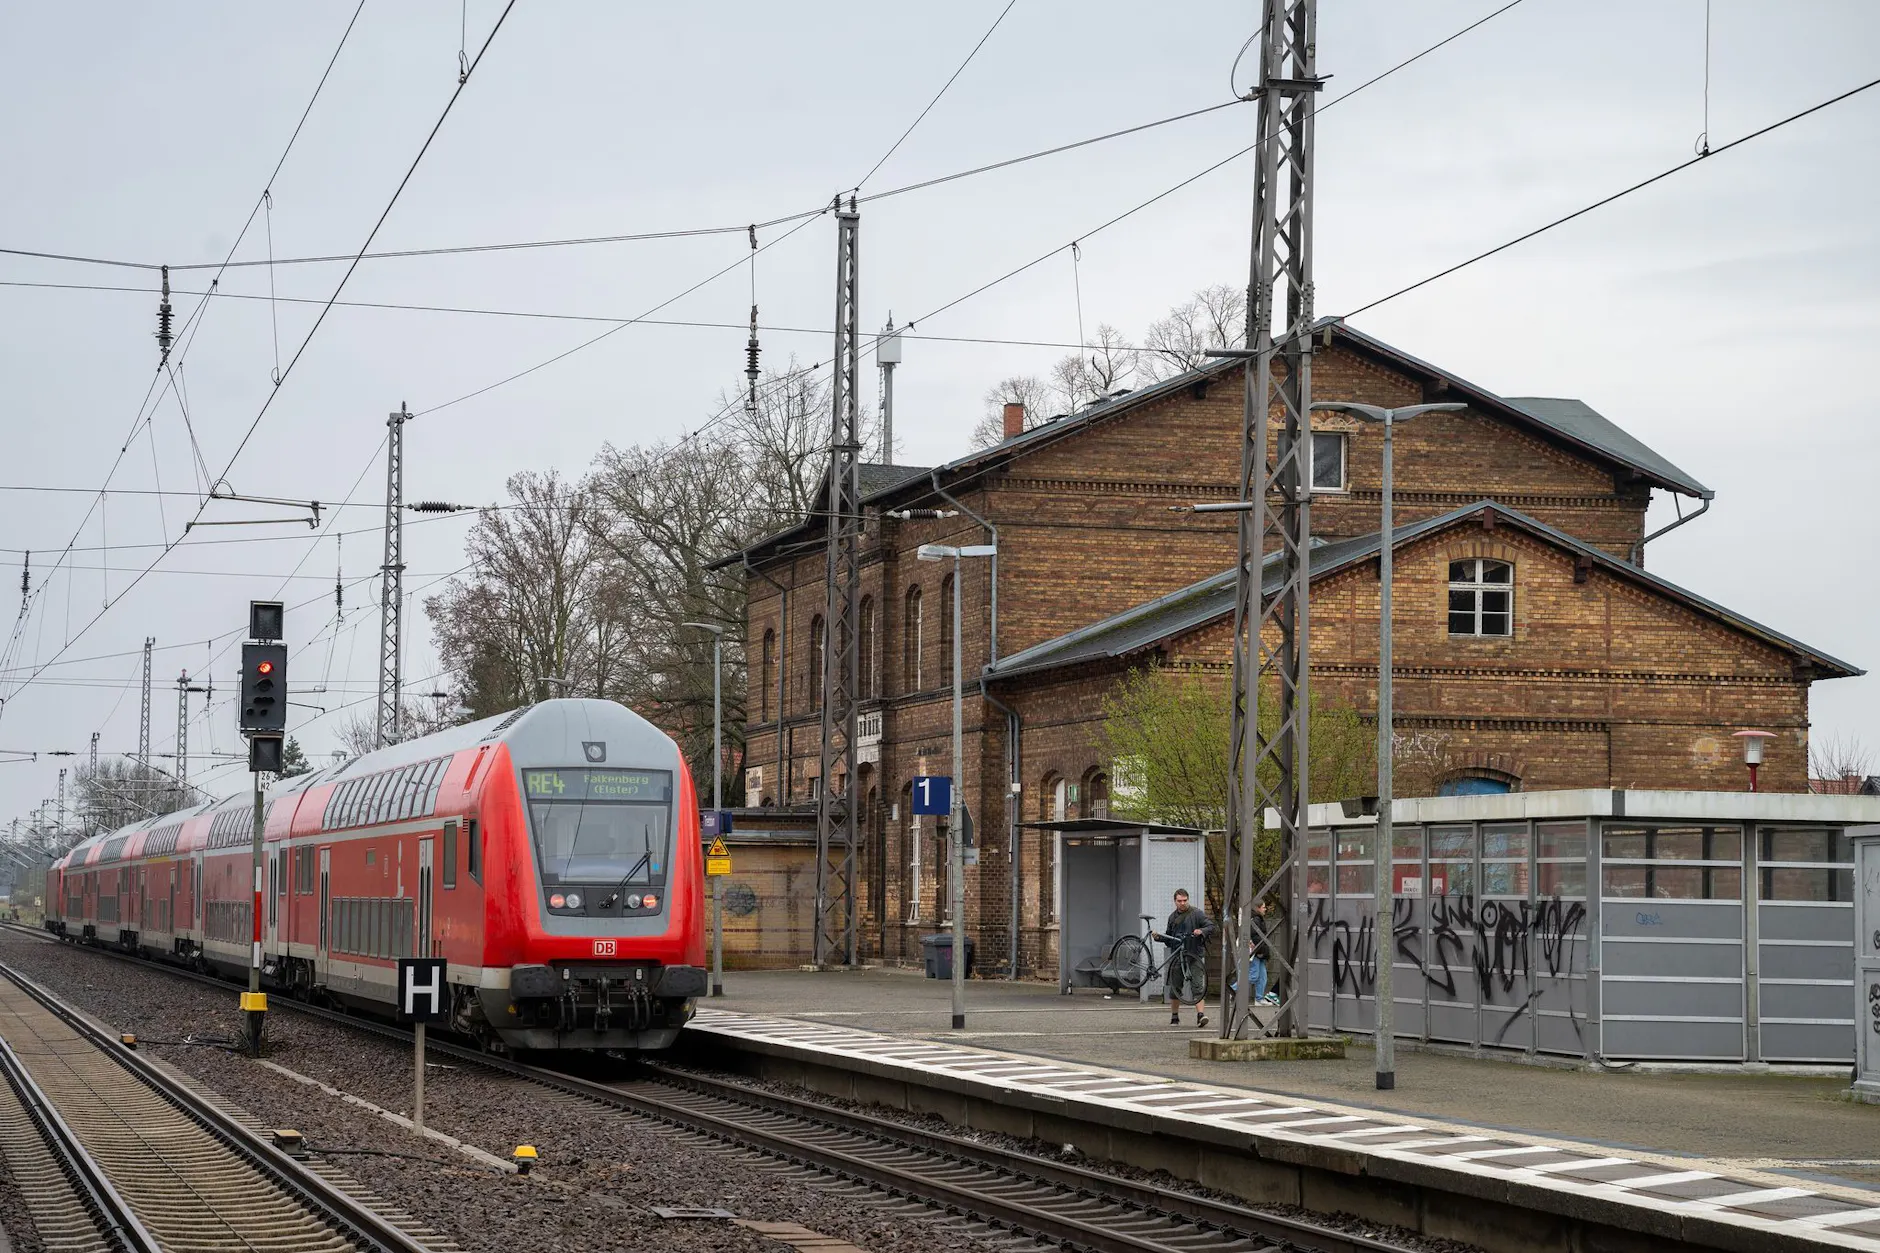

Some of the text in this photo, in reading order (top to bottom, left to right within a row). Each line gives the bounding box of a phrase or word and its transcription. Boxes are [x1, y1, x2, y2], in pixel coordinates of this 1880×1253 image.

[261, 772, 271, 781] 26
[583, 774, 649, 785] Falkenberg
[260, 782, 271, 791] N2
[528, 773, 565, 794] RE4
[594, 785, 639, 794] (Elster)
[918, 778, 930, 806] 1
[595, 942, 614, 954] DB
[405, 966, 440, 1013] H
